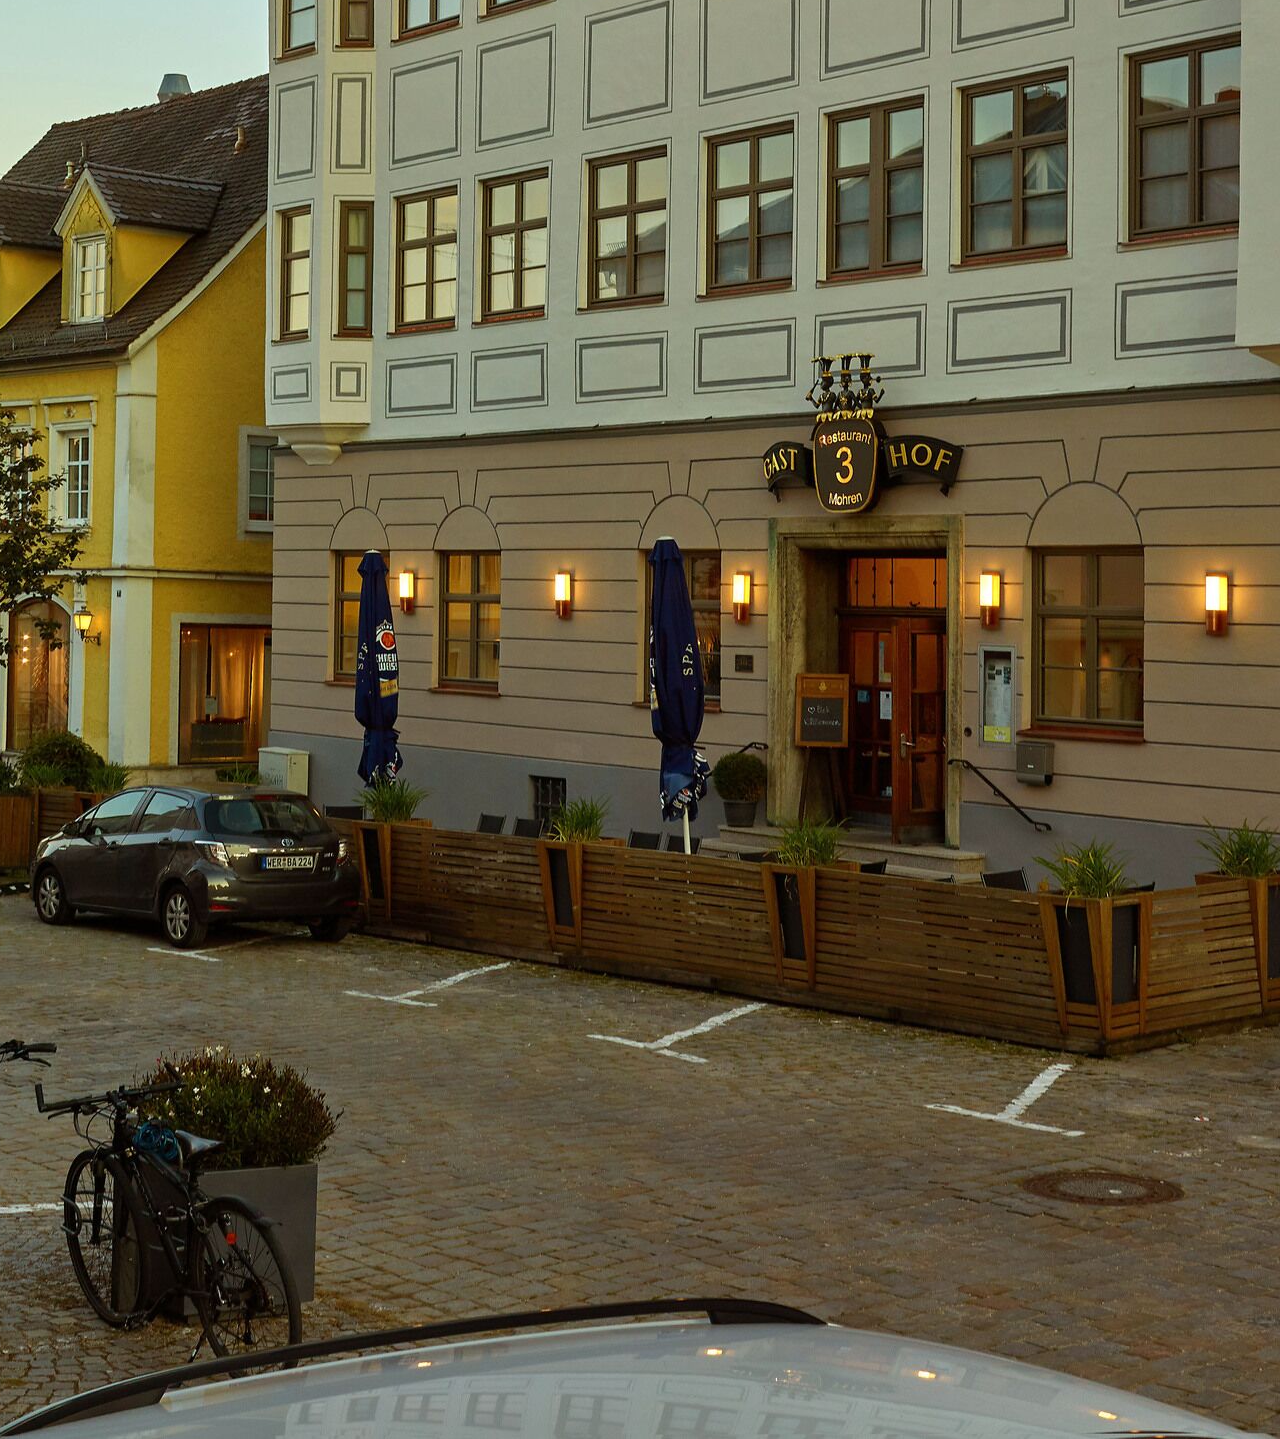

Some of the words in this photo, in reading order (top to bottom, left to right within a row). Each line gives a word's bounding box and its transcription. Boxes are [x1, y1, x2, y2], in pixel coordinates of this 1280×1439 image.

[818, 430, 872, 448] Restaurant
[763, 448, 798, 480] GAST
[889, 443, 953, 472] HOF
[835, 446, 854, 484] 3
[828, 491, 863, 506] Mohren
[267, 857, 282, 868] WER
[287, 858, 297, 867] BA
[298, 857, 312, 867] 224
